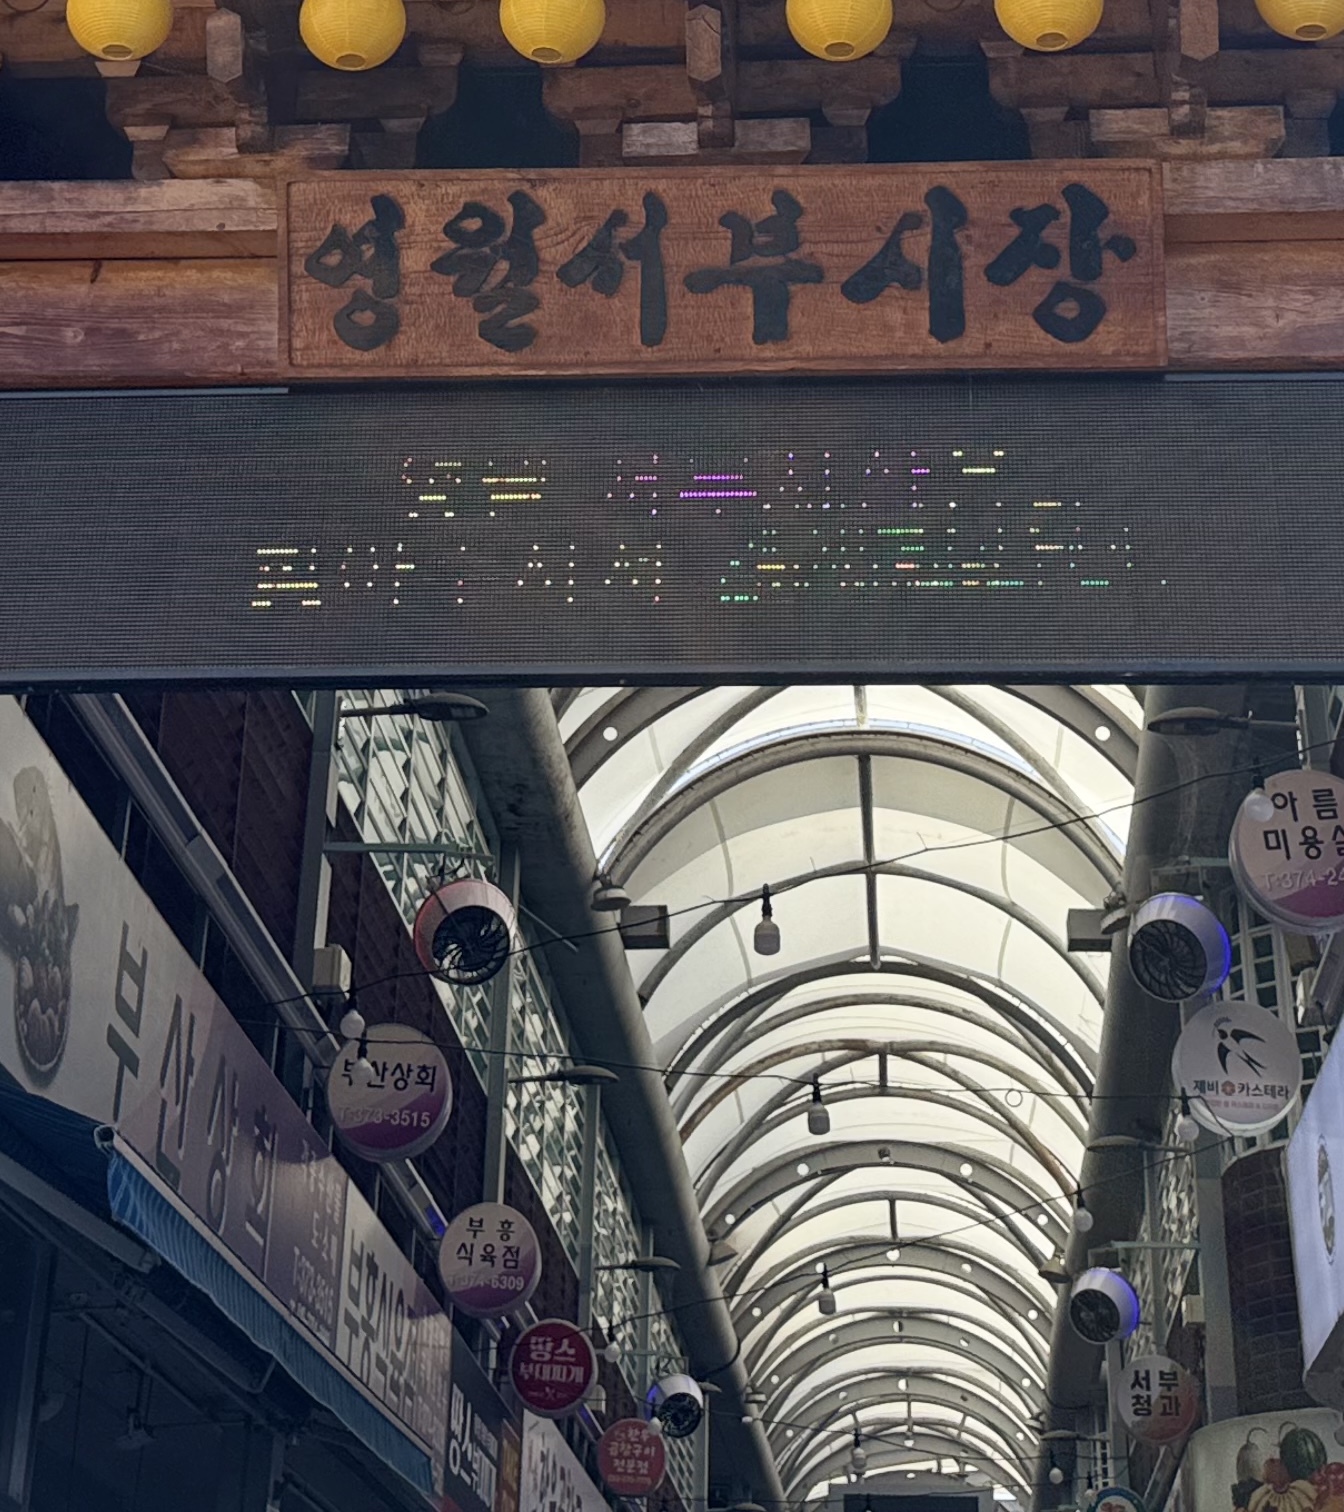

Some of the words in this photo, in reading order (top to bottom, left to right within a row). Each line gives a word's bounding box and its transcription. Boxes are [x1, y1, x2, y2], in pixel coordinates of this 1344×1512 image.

[303, 182, 1137, 353] 영월서부시장
[1270, 788, 1339, 823] 아름
[1237, 1082, 1289, 1101] 카스테라
[456, 1241, 521, 1270] 식육점
[529, 1336, 577, 1362] 땅스
[1130, 1369, 1180, 1392] 서부
[1131, 1394, 1182, 1417] 청과
